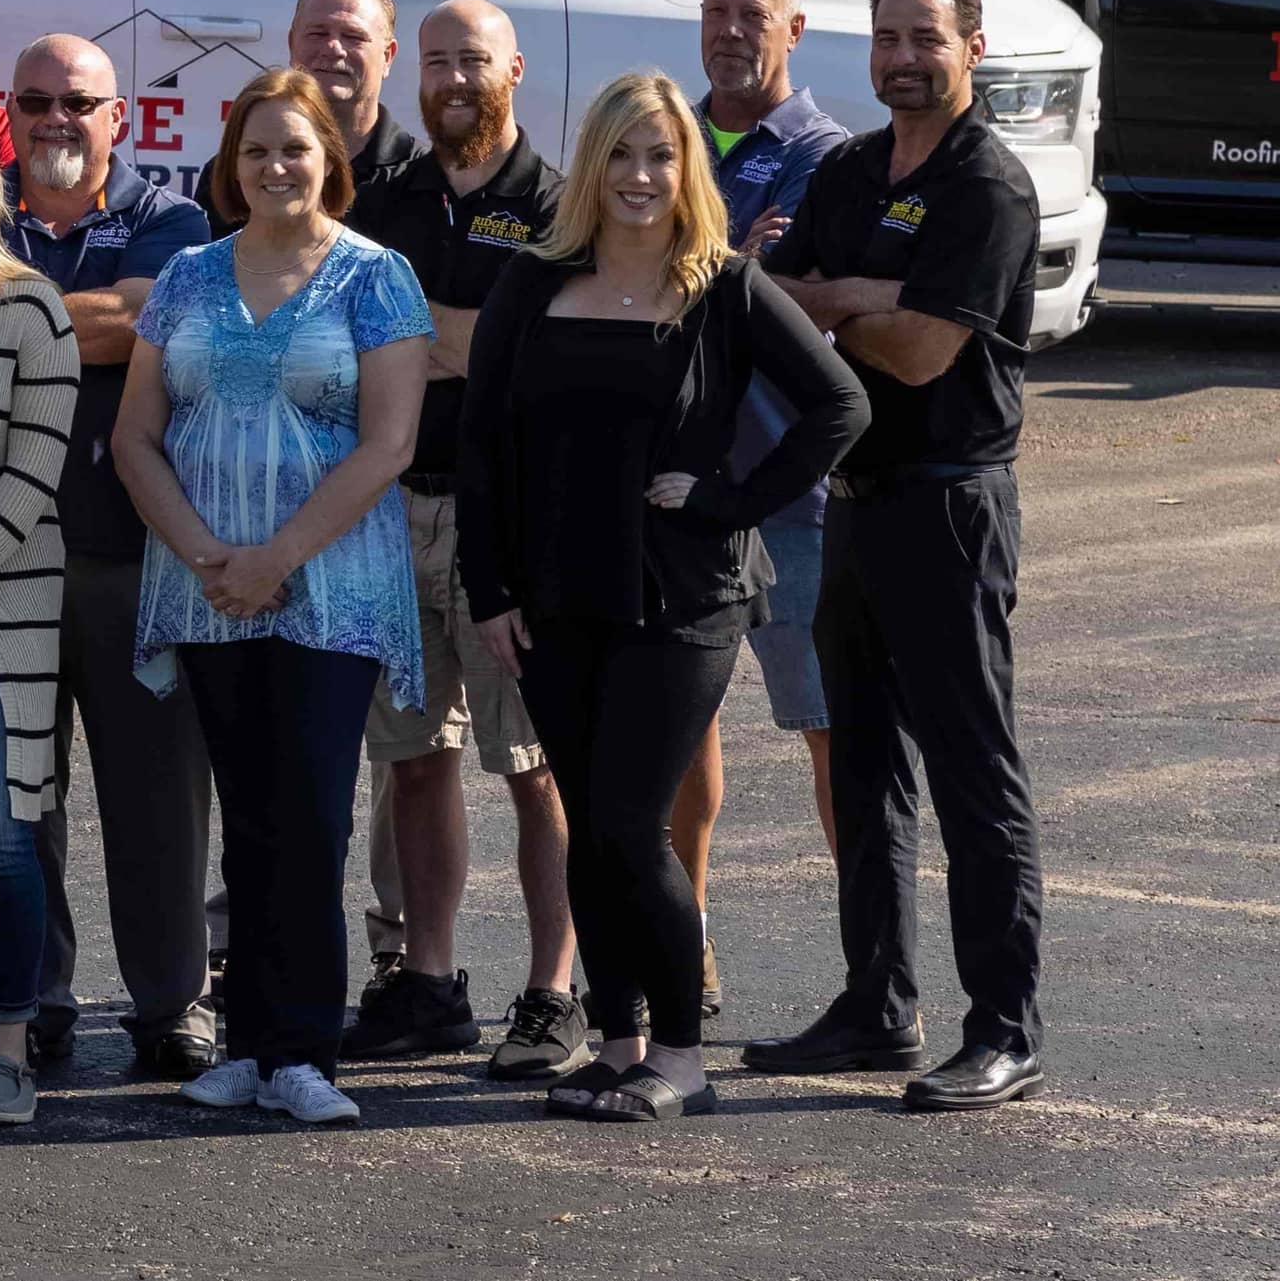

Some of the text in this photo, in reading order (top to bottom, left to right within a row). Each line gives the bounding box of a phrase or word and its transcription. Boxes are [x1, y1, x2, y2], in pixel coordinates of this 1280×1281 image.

[470, 223, 529, 242] EXTERIORS
[471, 215, 532, 234] RIDGE TOP
